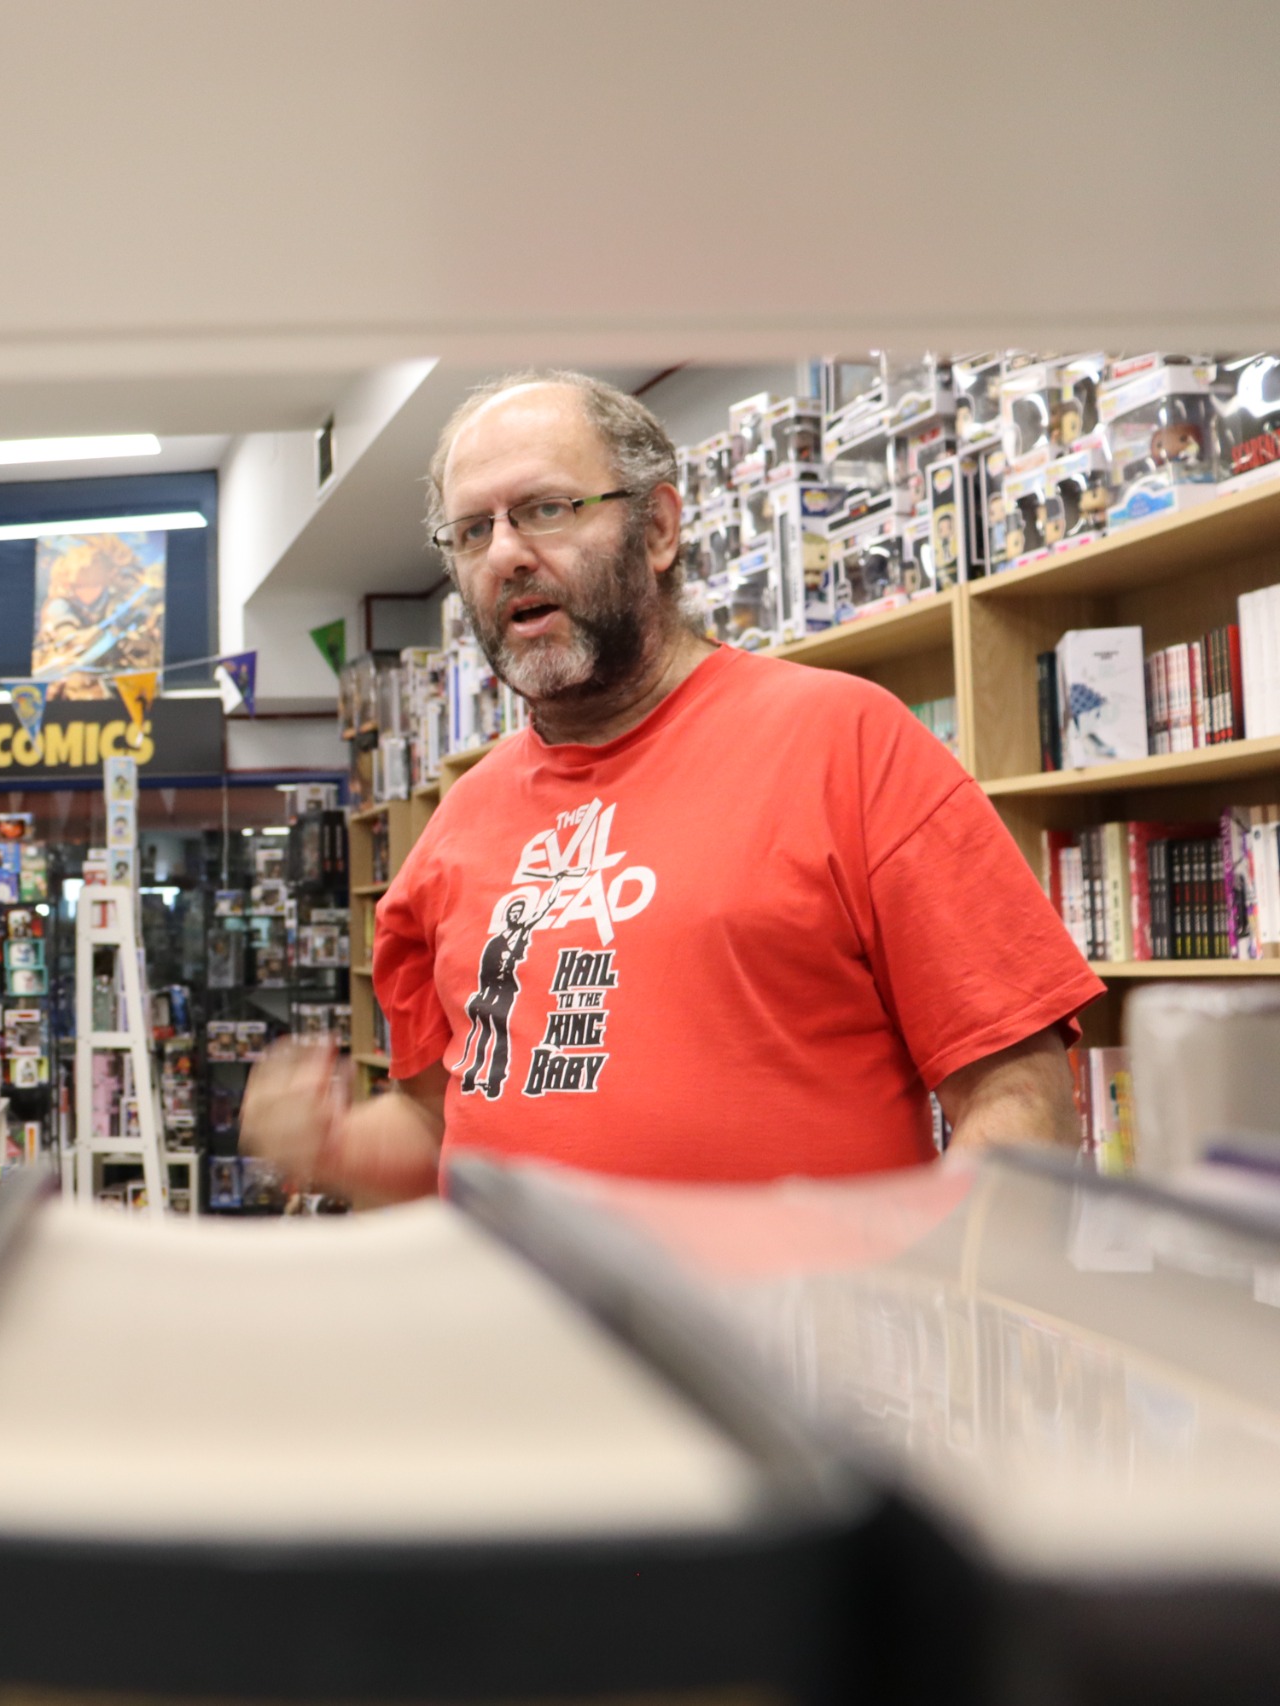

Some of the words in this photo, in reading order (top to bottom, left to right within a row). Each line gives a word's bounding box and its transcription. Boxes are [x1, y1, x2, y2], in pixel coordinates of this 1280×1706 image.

[556, 803, 590, 829] THE
[511, 797, 627, 885] EVIL
[487, 865, 657, 947] DEAD
[551, 948, 618, 992] HAIL
[557, 993, 573, 1009] TO
[578, 991, 602, 1007] THE
[544, 1011, 606, 1049] KING
[523, 1049, 608, 1096] BABY
